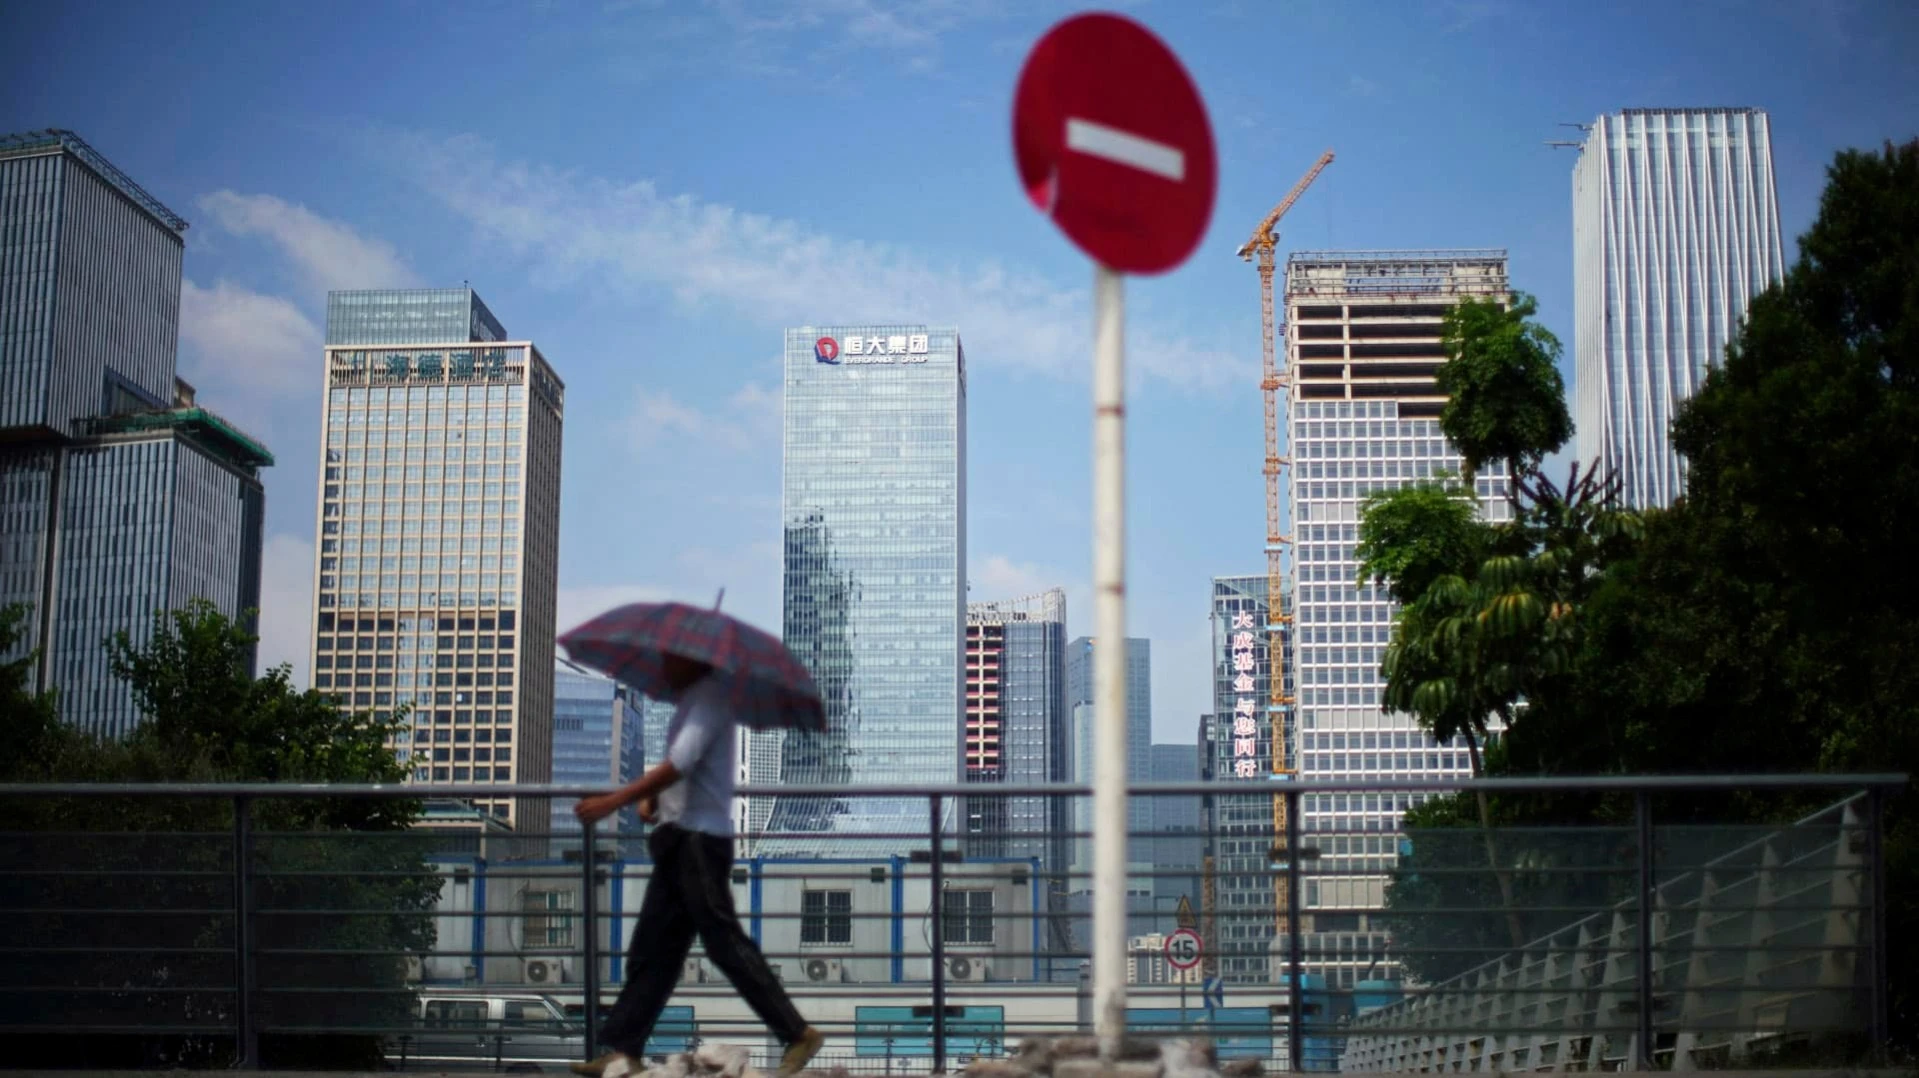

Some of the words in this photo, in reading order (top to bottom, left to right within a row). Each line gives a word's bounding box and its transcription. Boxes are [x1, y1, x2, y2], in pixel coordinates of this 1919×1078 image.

[844, 335, 928, 355] 恒大集团
[901, 355, 928, 364] GROUP
[1172, 940, 1194, 960] 15
